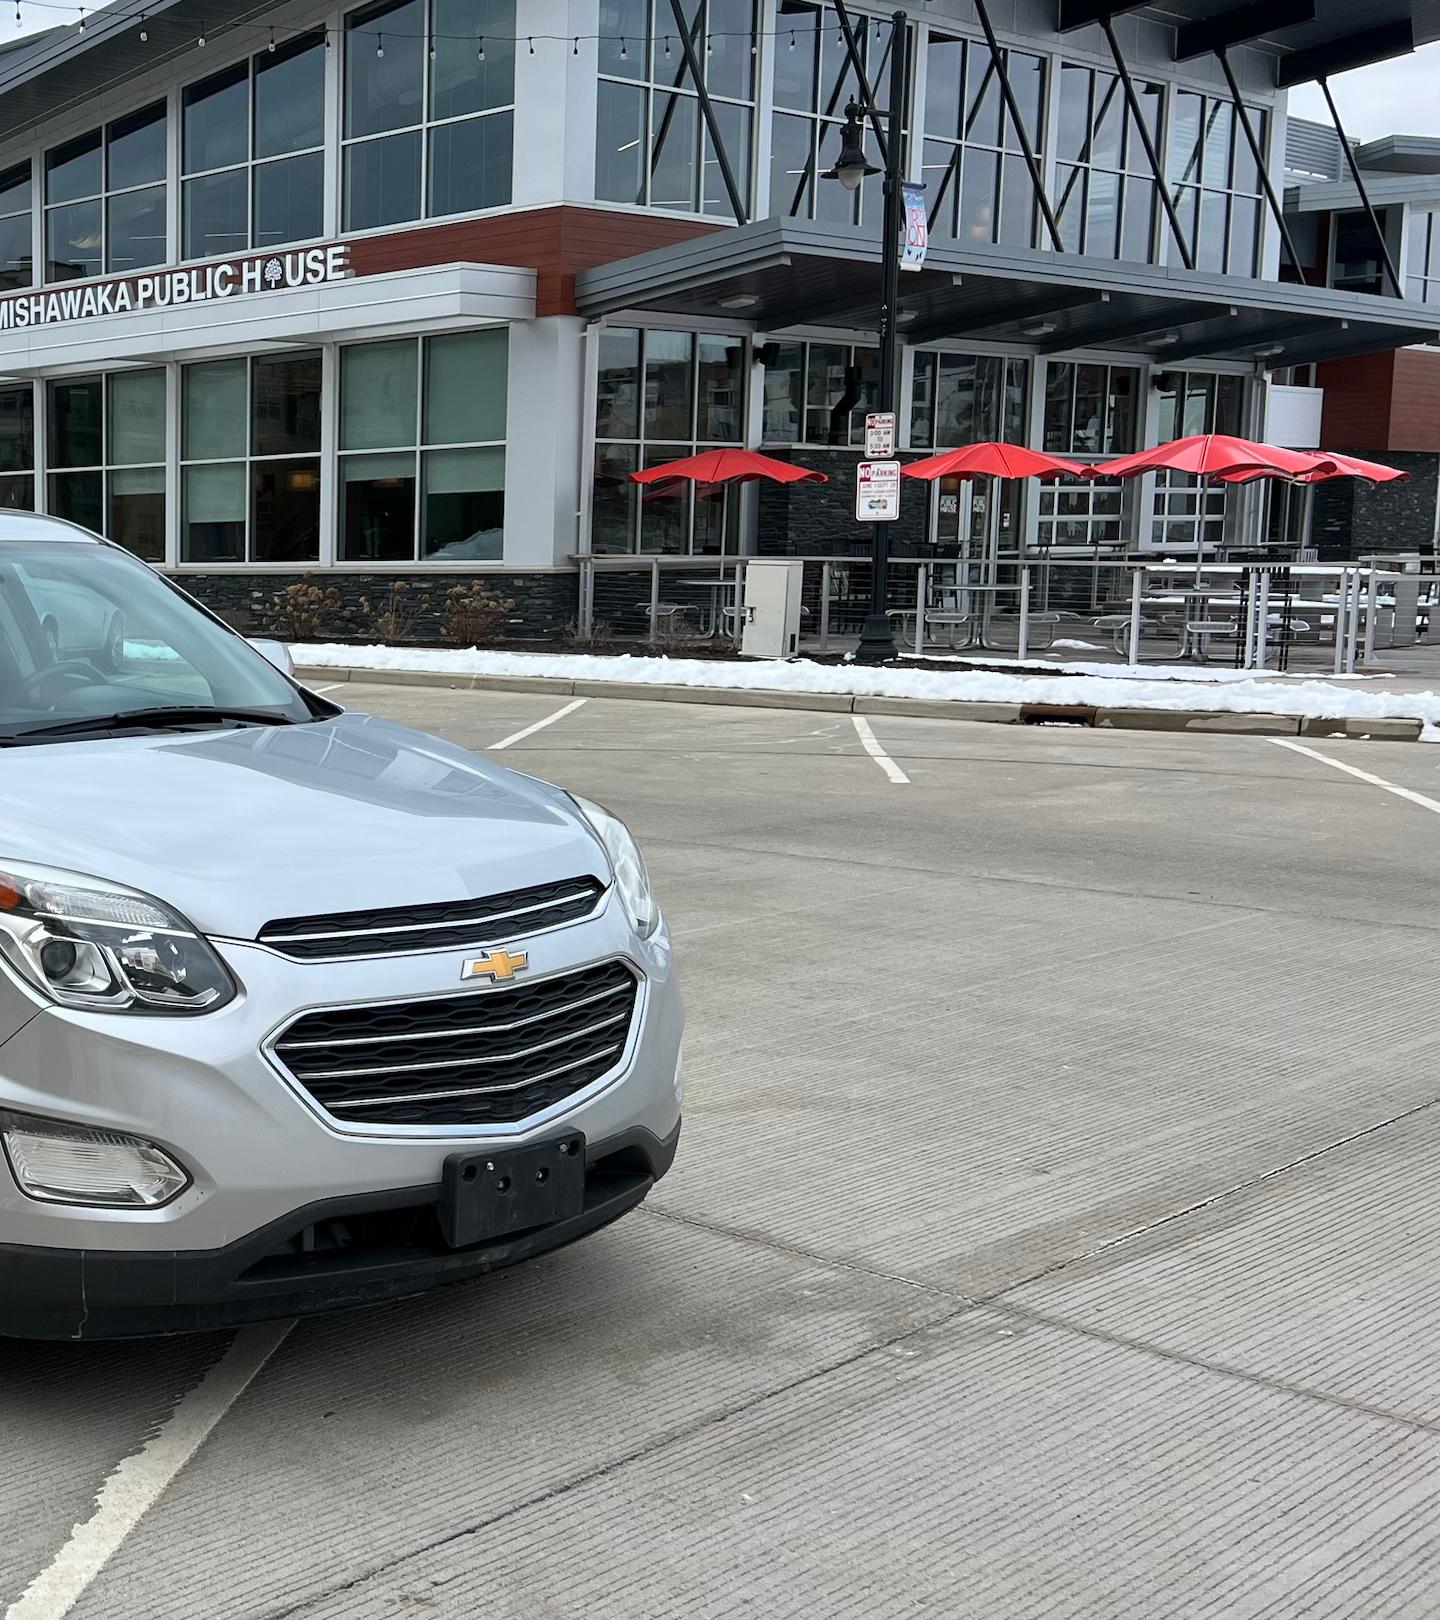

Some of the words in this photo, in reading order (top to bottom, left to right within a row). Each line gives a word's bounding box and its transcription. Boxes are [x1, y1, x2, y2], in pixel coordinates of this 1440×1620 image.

[138, 264, 234, 309] PUBLIC
[860, 466, 871, 479] NO
[872, 468, 897, 478] PARKING
